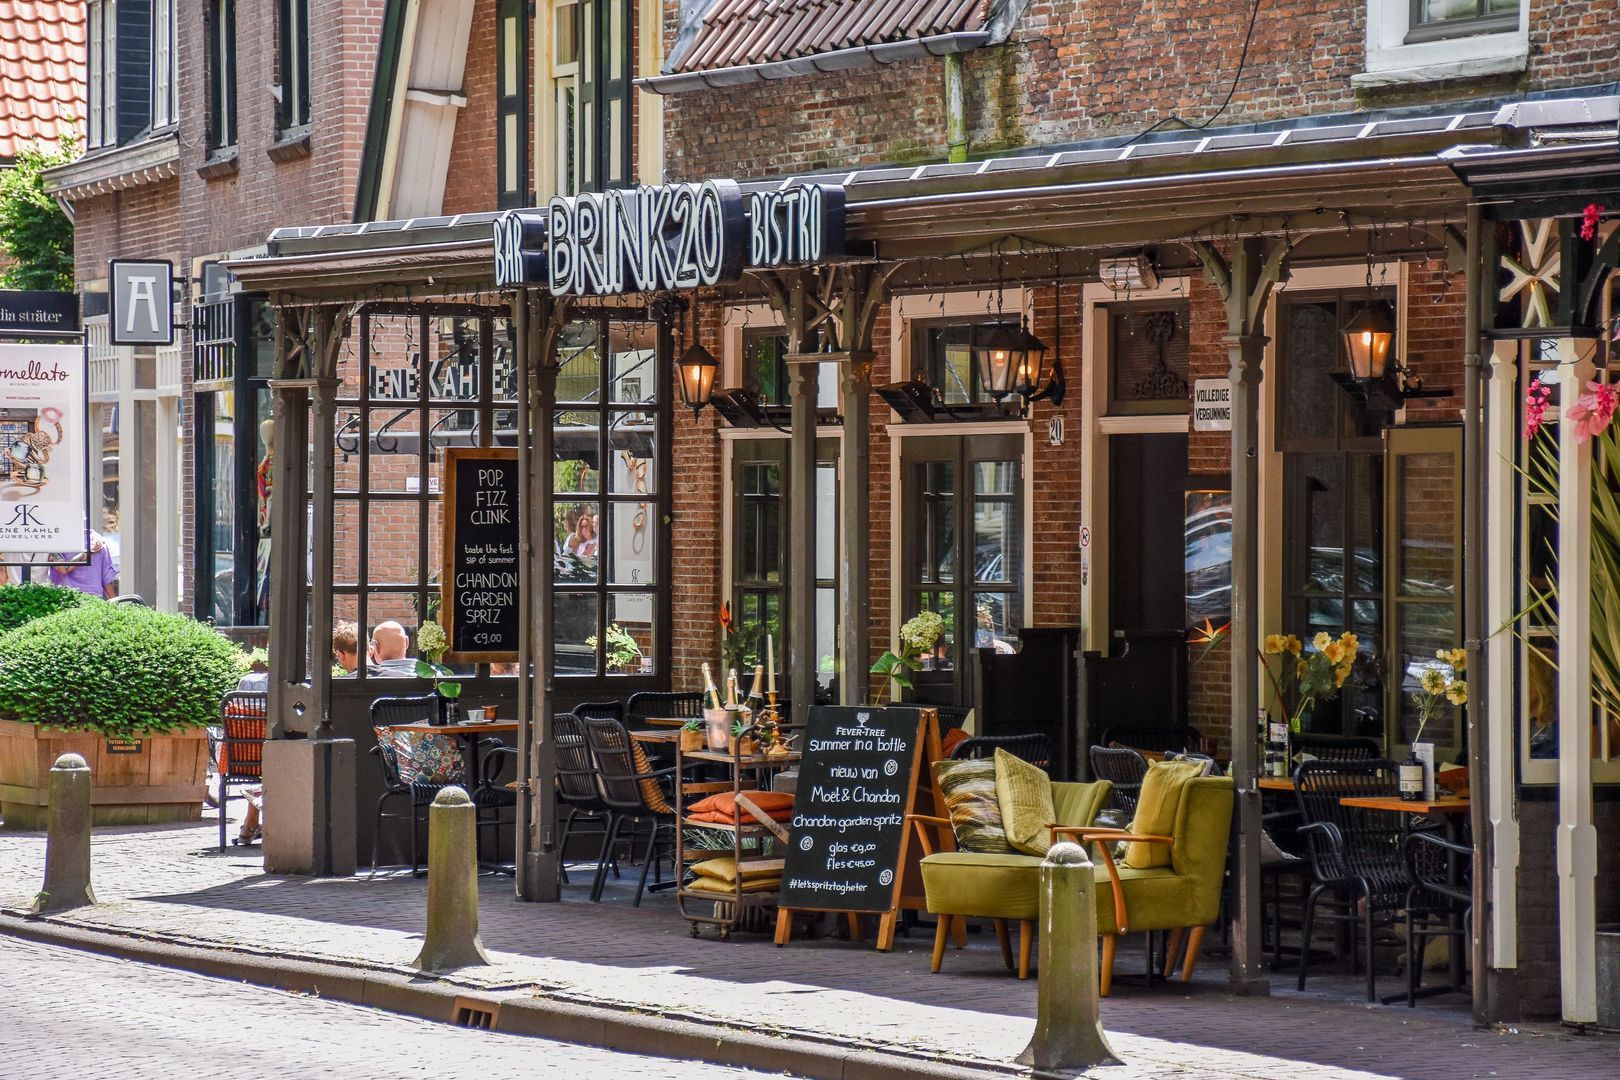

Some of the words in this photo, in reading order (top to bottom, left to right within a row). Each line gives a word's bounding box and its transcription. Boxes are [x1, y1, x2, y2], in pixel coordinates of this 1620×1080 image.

[492, 217, 524, 287] BAR
[549, 178, 725, 297] BRINK20
[750, 183, 822, 268] BISTRO
[369, 353, 419, 399] ENÉ
[1196, 388, 1230, 403] VOLLEDIGE
[1195, 407, 1231, 422] VERGUNNING
[1050, 418, 1062, 441] 20
[470, 509, 511, 525] CLINK
[464, 543, 483, 554] taste
[485, 543, 498, 554] the
[499, 543, 514, 554] first
[478, 554, 487, 565] of
[456, 572, 518, 589] CHANDON
[460, 591, 513, 607] GARDEN
[466, 608, 501, 624] SPRIZ
[473, 632, 502, 645] €9.00
[836, 726, 886, 738] FEVER-TREE
[877, 737, 907, 752] bottle
[831, 765, 858, 779] nieuw
[861, 766, 878, 780] van
[811, 785, 841, 803] Moët
[841, 788, 850, 801] &
[852, 786, 900, 804] Chandon
[838, 815, 873, 833] garden
[873, 813, 902, 832] spritz
[829, 842, 848, 857] glas
[826, 857, 846, 871] fles
